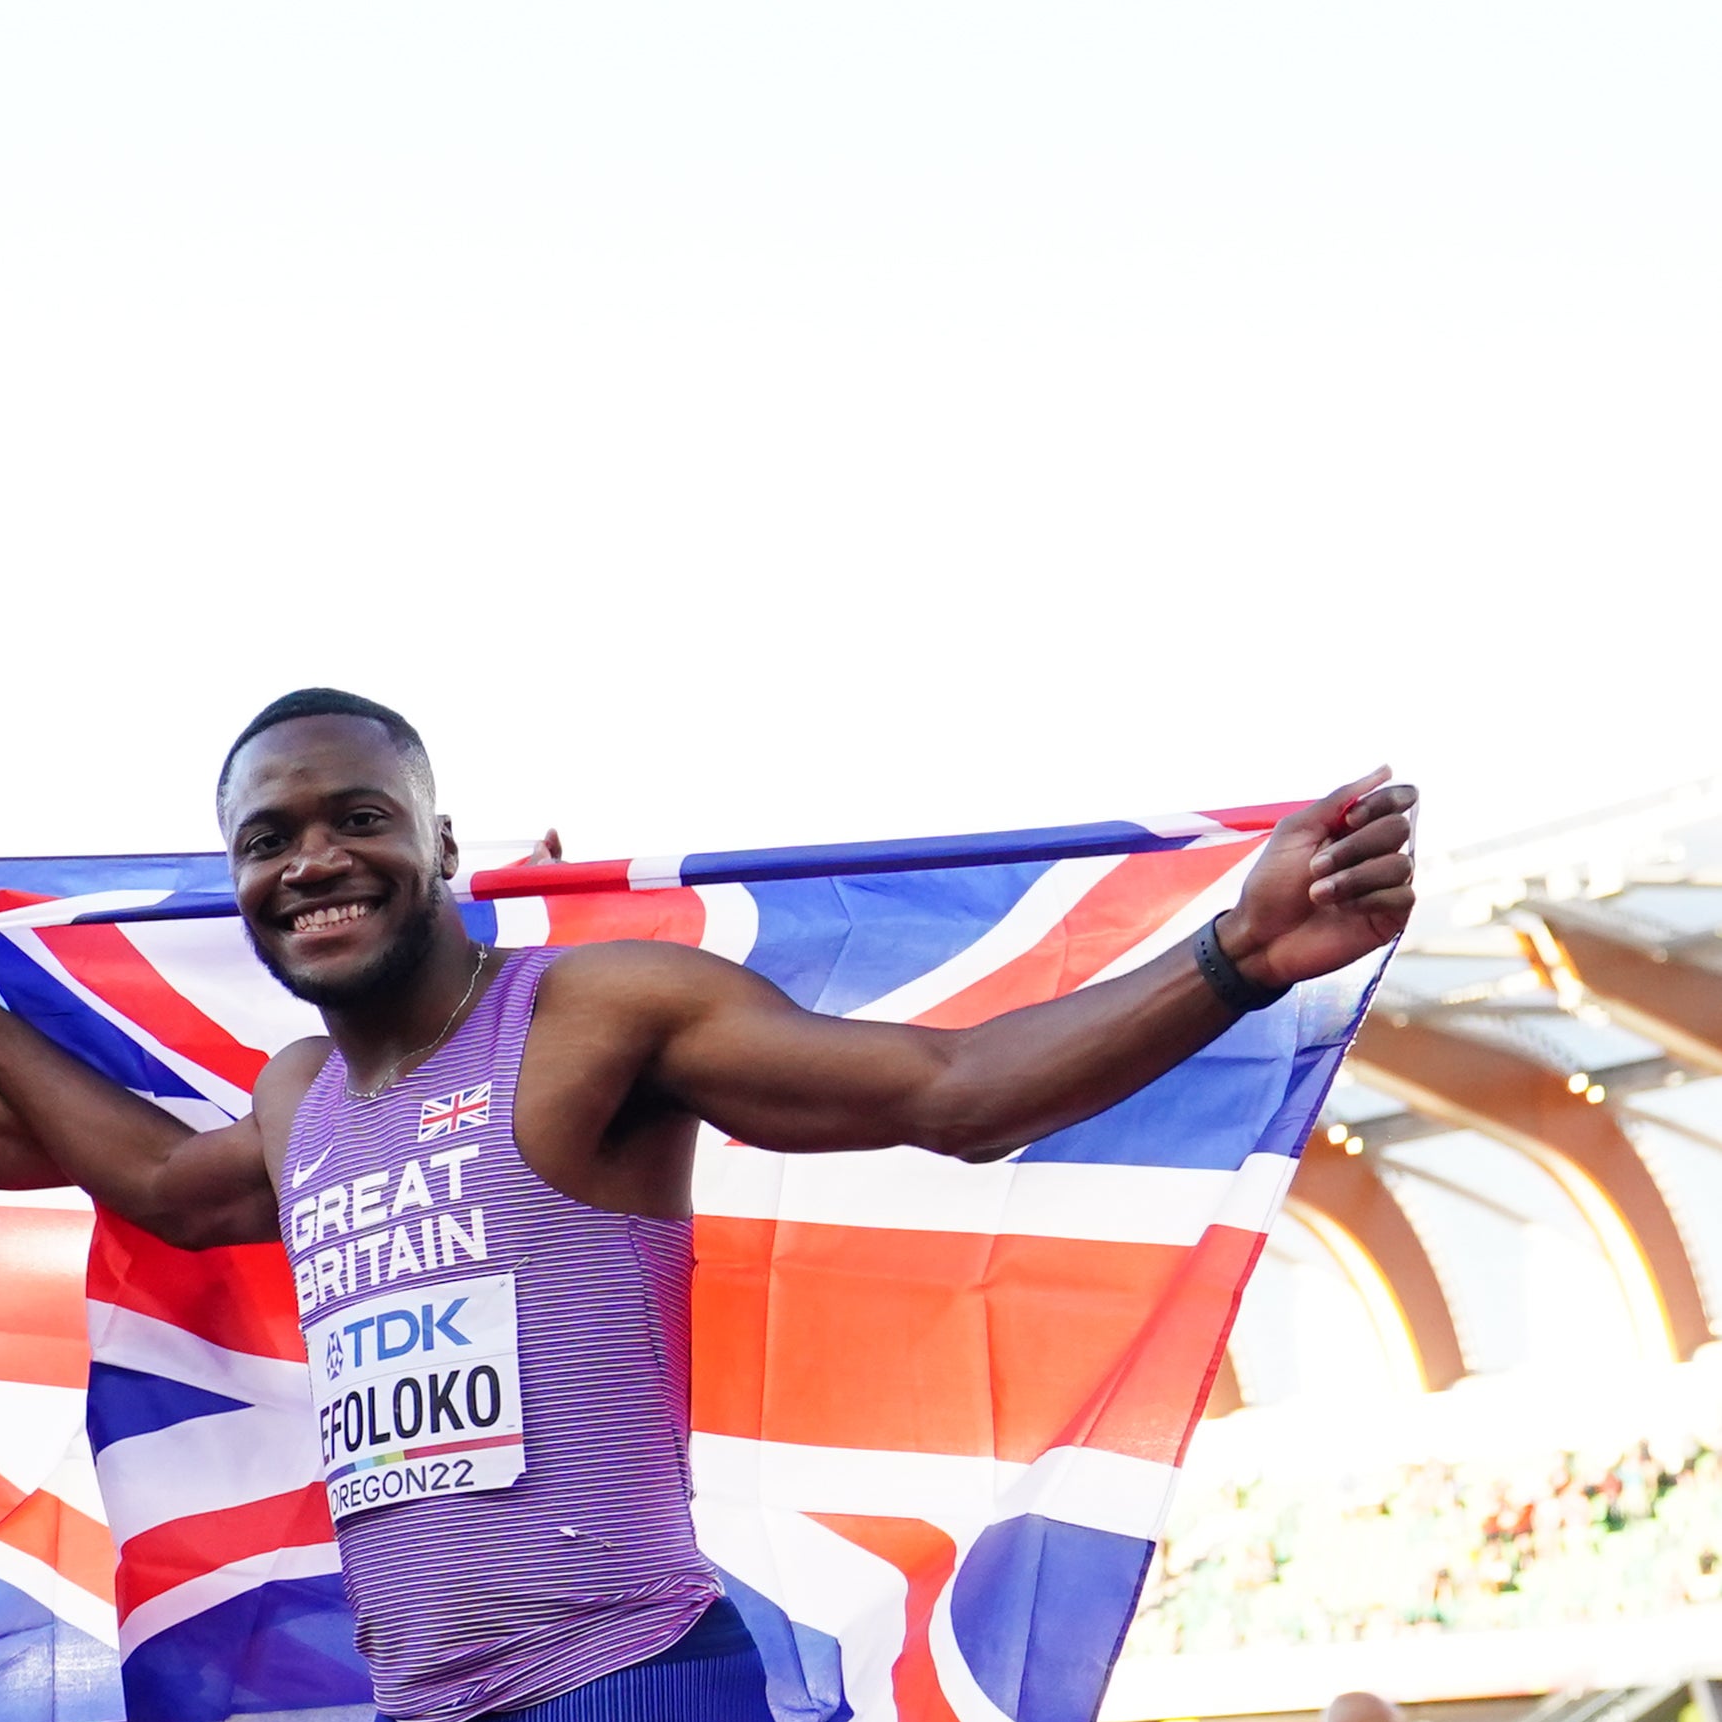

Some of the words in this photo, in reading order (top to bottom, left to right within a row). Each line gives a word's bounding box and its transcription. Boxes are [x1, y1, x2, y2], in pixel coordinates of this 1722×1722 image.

[291, 1144, 480, 1252] GREAT
[296, 1208, 488, 1315] BRITAIN
[343, 1296, 473, 1368] TDK
[320, 1364, 502, 1466] EFOLOKO
[331, 1459, 475, 1516] OREGON22
